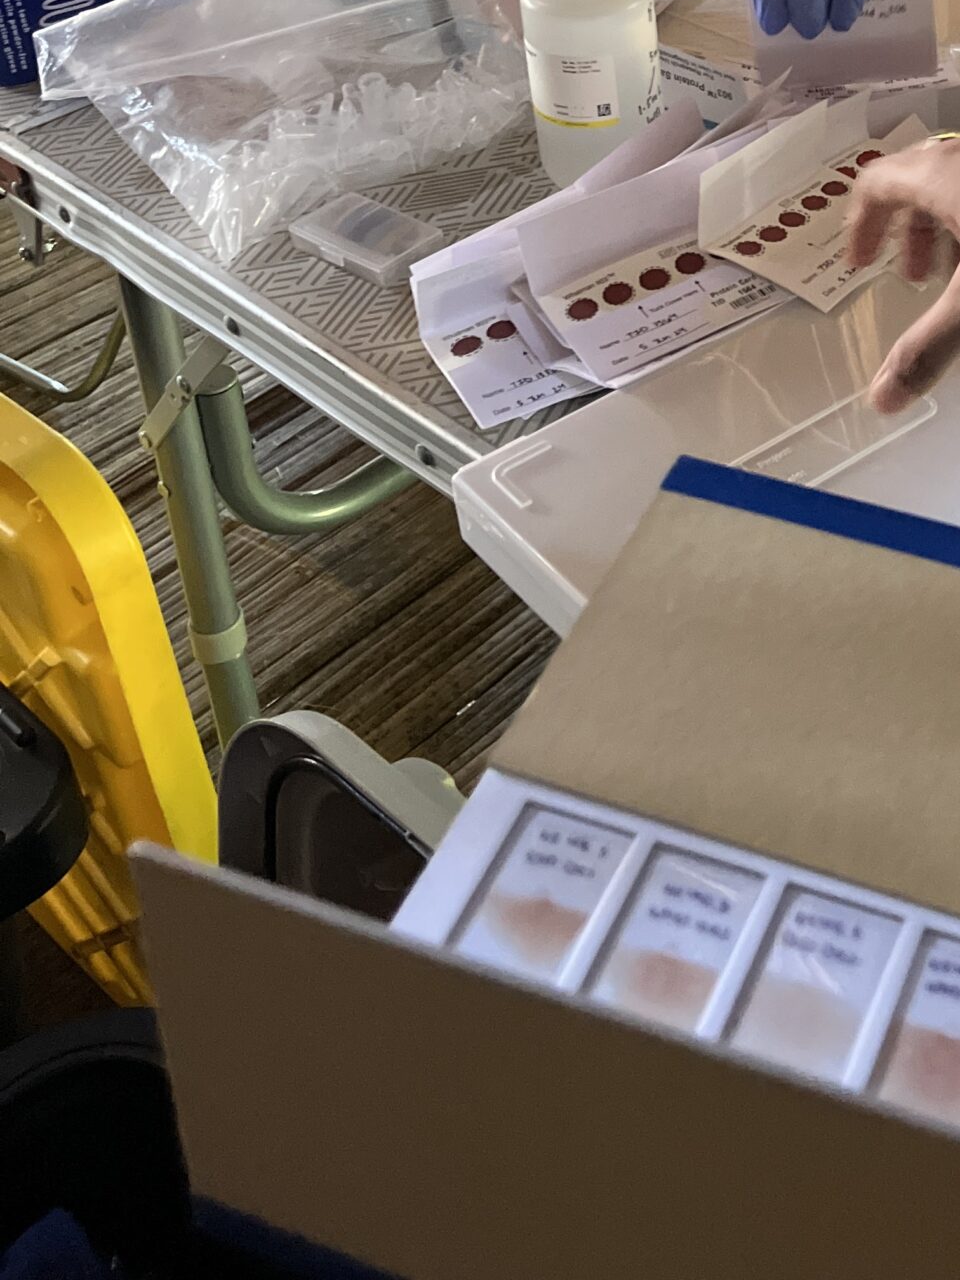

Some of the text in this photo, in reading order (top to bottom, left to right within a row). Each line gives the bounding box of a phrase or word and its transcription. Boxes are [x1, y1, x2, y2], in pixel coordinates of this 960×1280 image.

[18, 9, 30, 33] touch
[8, 19, 28, 70] powder-free
[3, 46, 17, 74] gloves
[660, 68, 671, 80] Sa
[673, 74, 706, 92] Protein
[709, 283, 738, 298] Protein
[711, 298, 726, 308] TID
